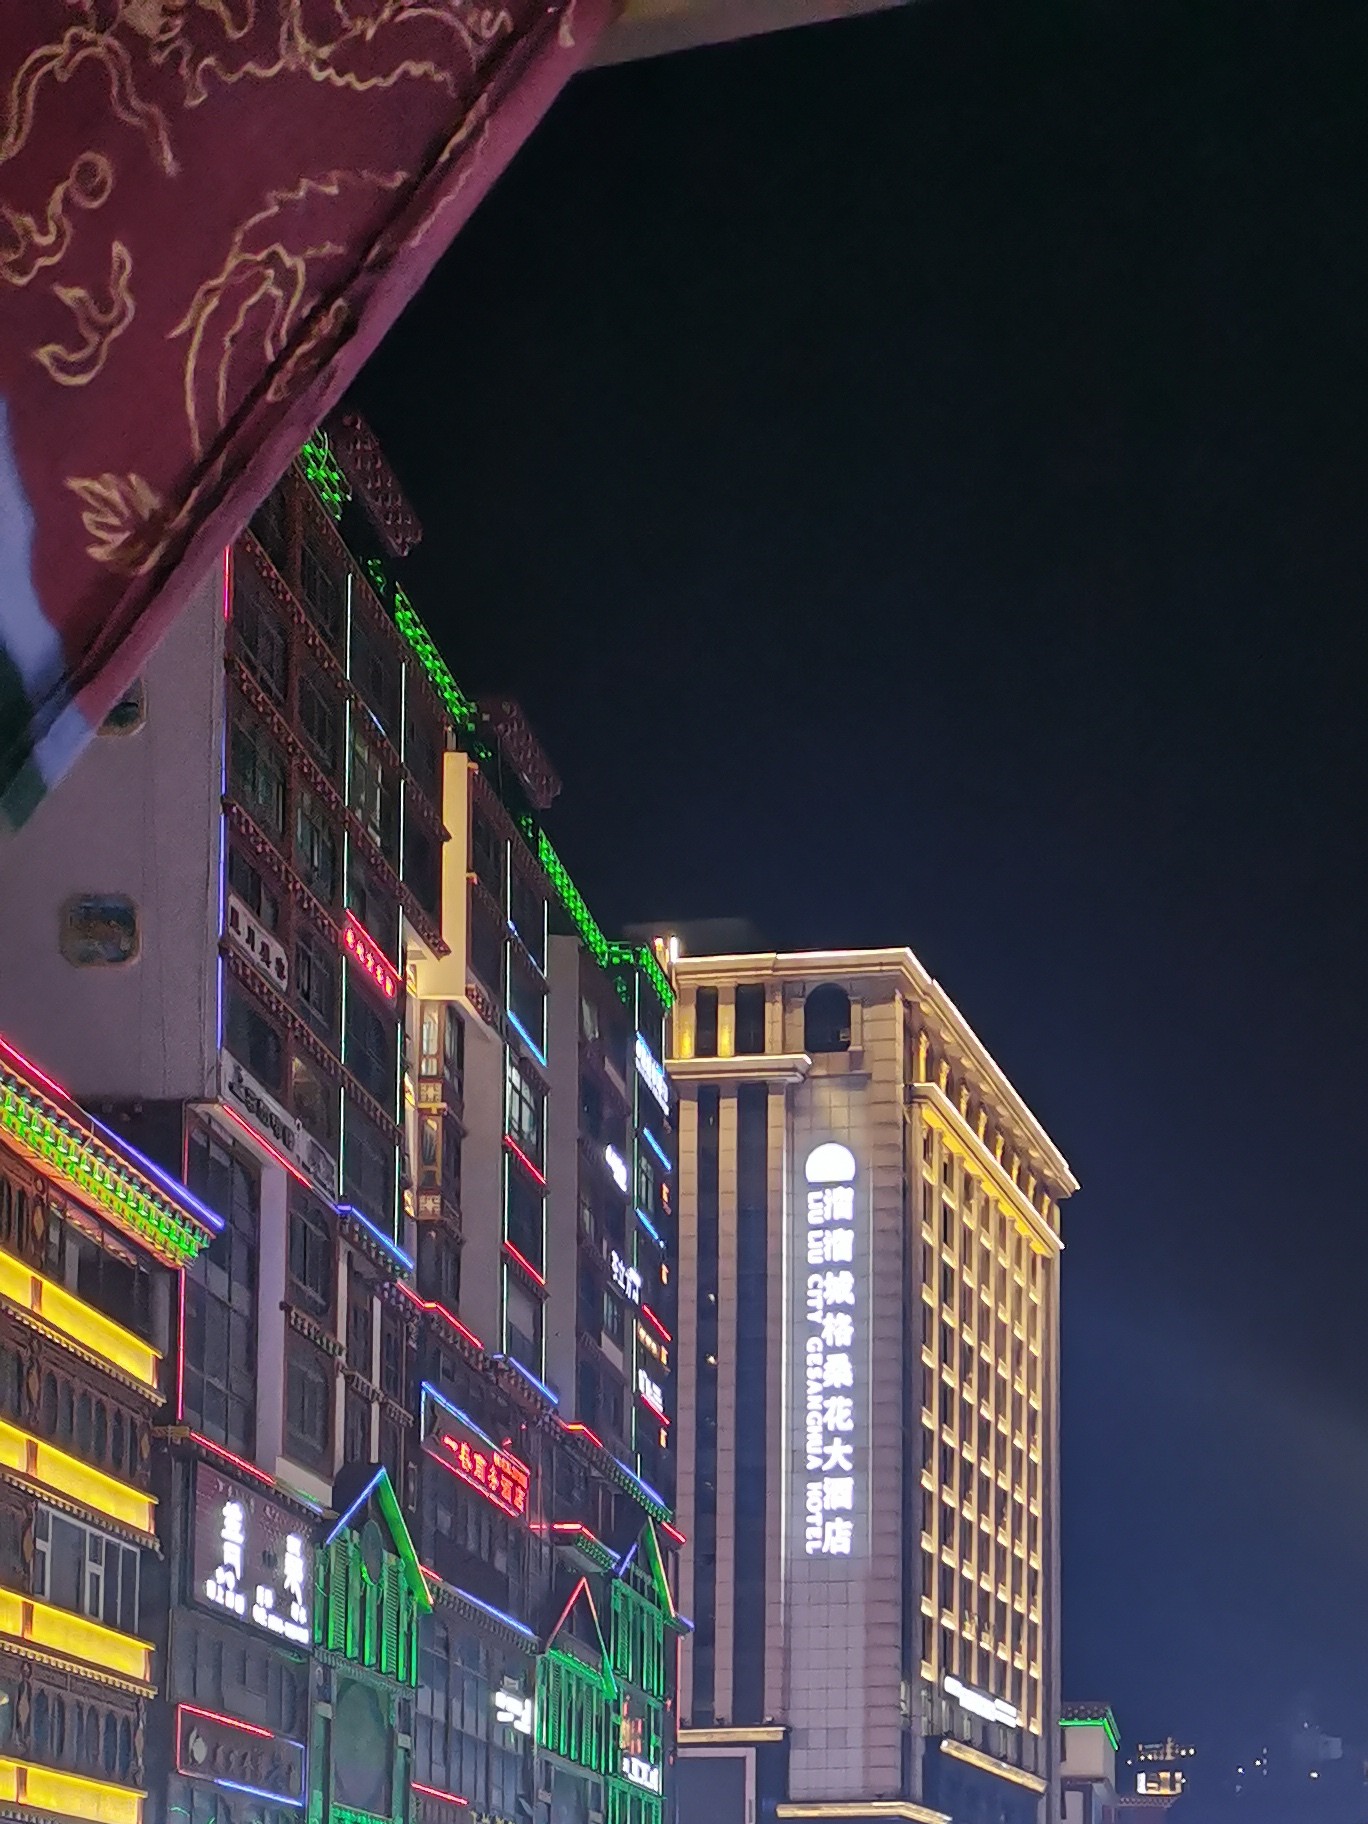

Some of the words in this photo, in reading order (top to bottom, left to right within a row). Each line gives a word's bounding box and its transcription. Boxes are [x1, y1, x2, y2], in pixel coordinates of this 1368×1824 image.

[806, 1190, 825, 1225] LIU
[806, 1229, 825, 1265] LIU
[805, 1273, 825, 1324] CITY
[822, 1185, 855, 1555] 溜溜城格桑花大酒店
[804, 1481, 824, 1555] HOTEL
